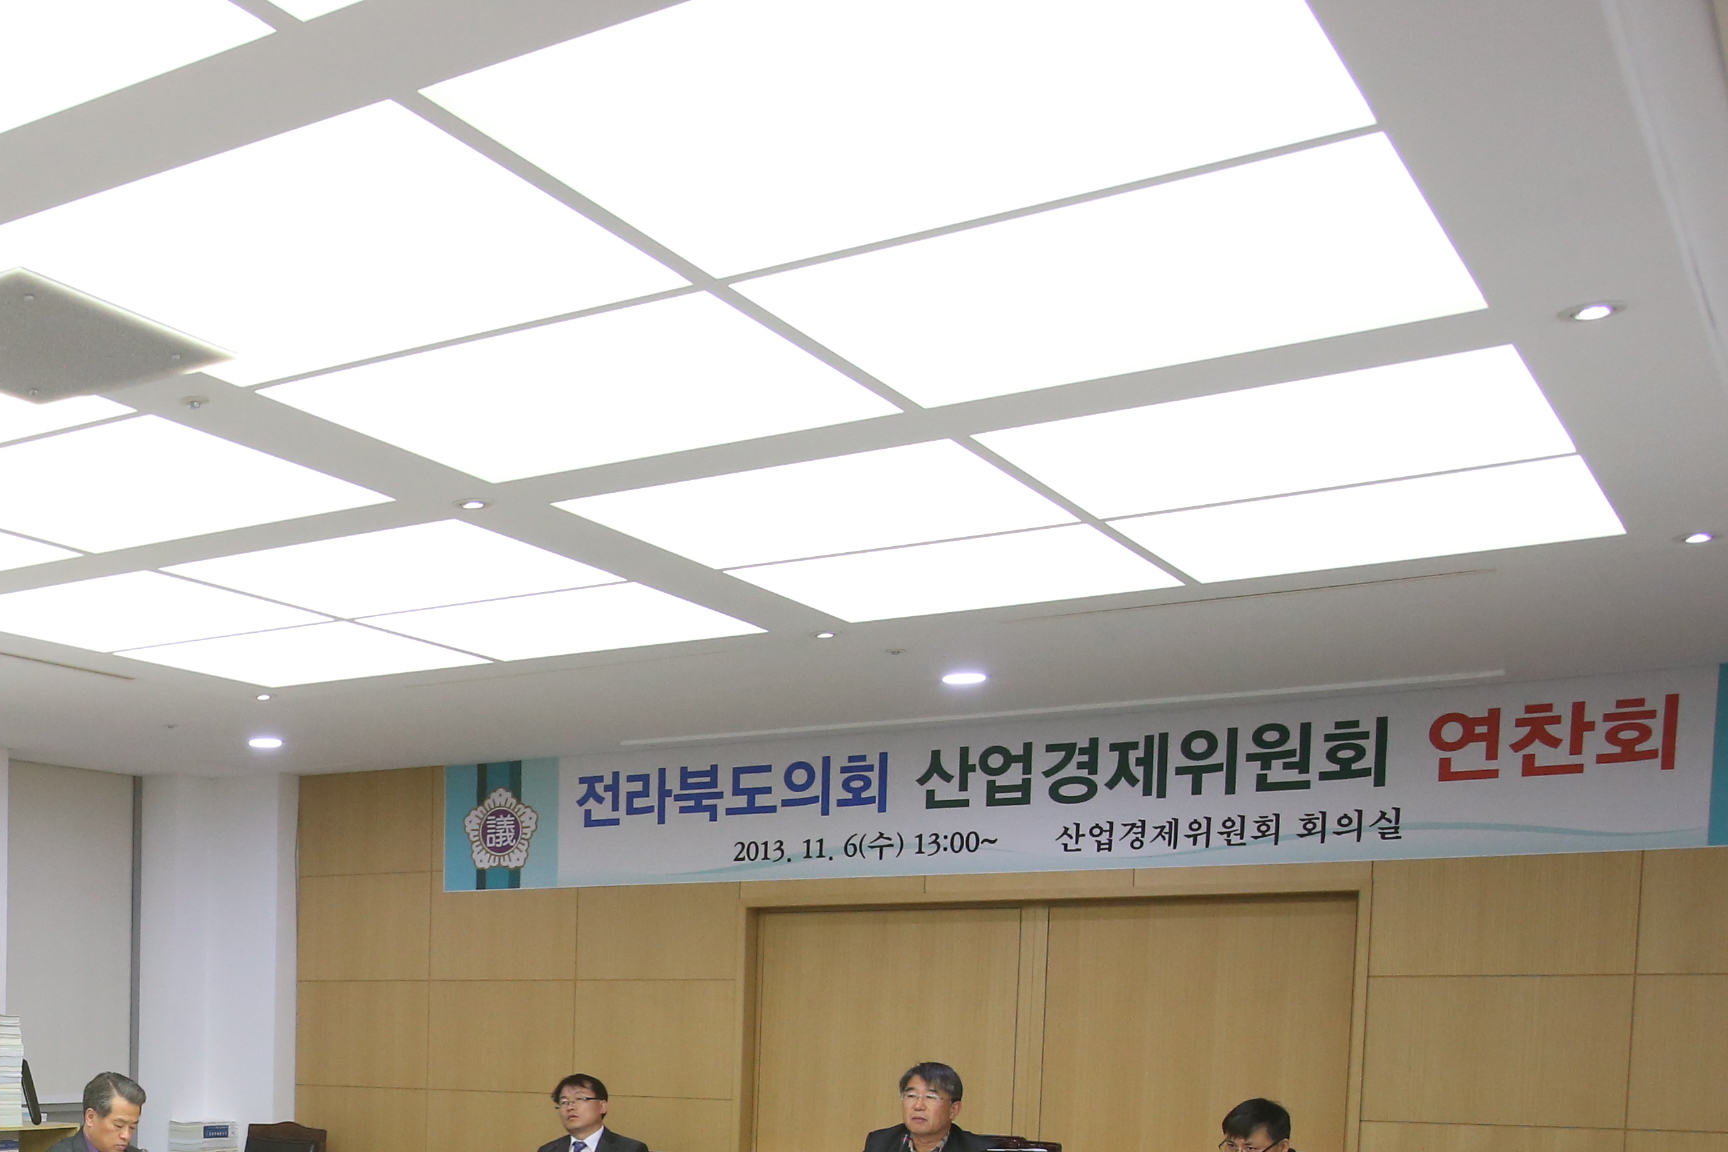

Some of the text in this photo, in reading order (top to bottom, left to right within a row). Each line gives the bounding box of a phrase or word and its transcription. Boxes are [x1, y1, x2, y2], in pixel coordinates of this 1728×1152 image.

[575, 693, 1680, 828] 전라북도의회 산업경제위원회 연찬회
[484, 815, 517, 848] 議
[733, 806, 1402, 864] 2013. 11. 6(수) 13:00~ 산업경제위원회 회의실
